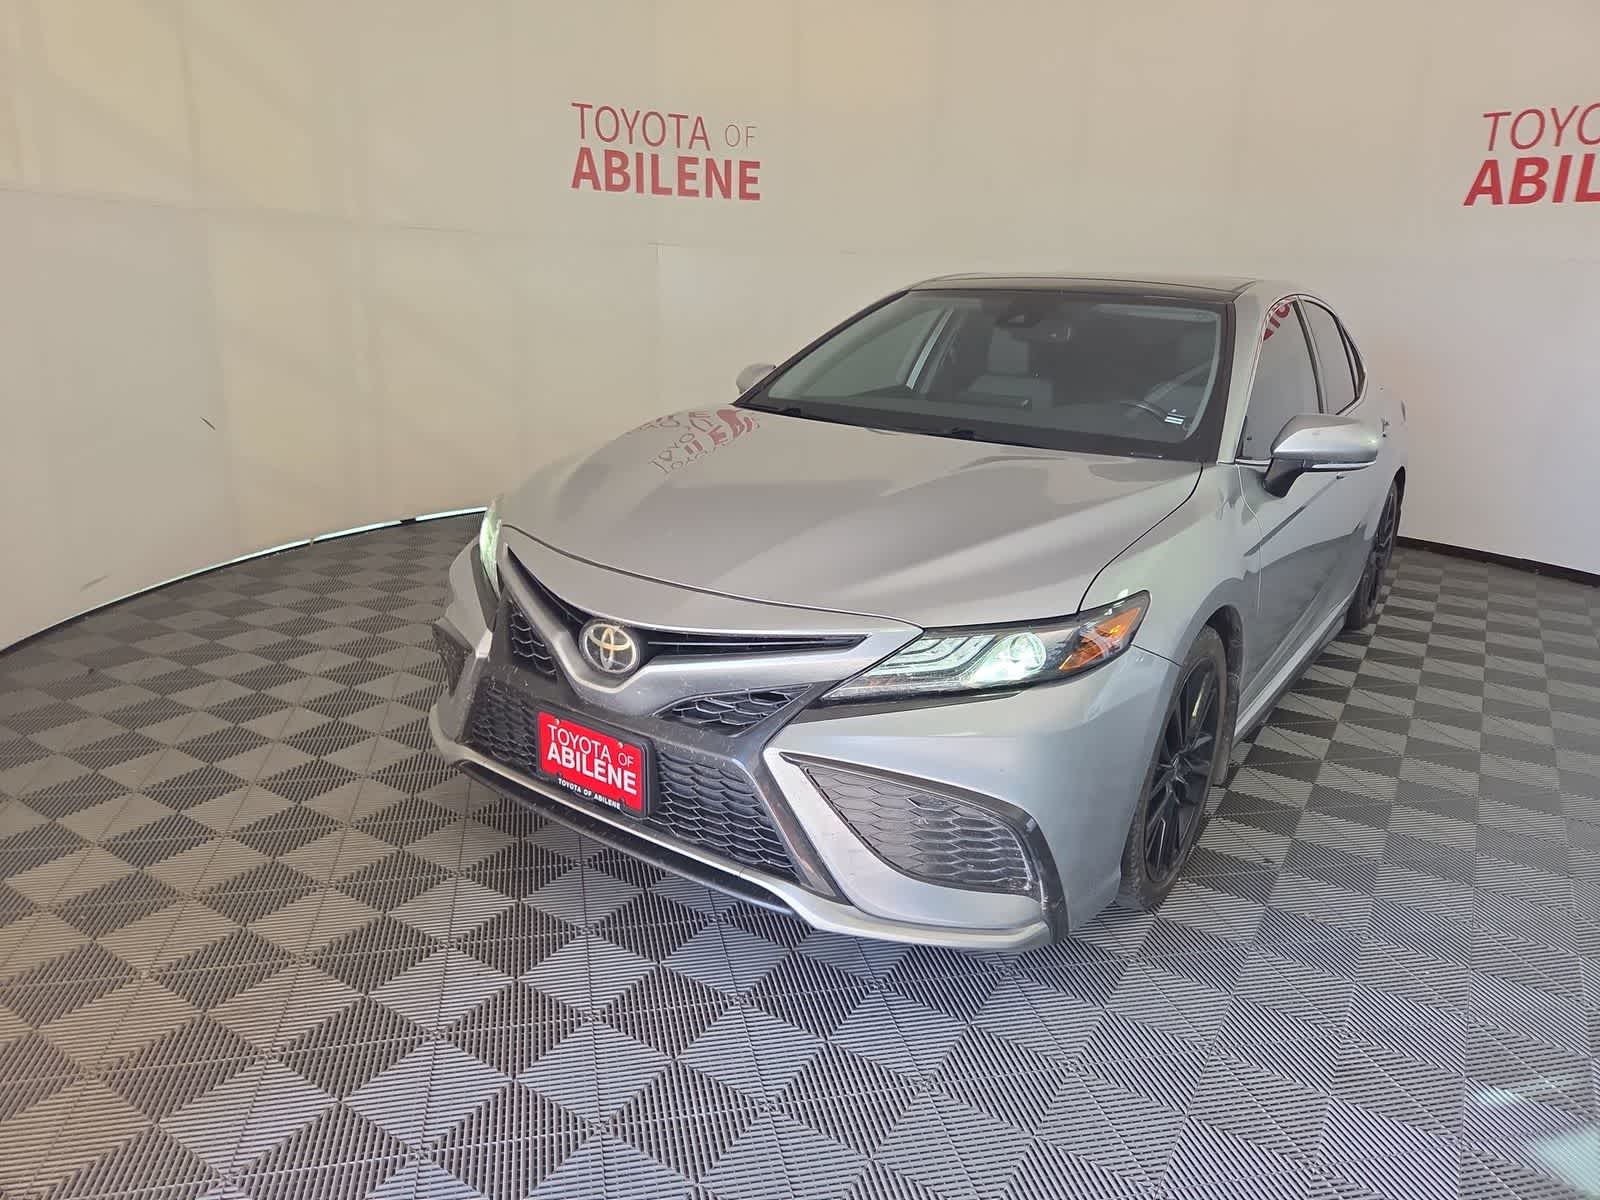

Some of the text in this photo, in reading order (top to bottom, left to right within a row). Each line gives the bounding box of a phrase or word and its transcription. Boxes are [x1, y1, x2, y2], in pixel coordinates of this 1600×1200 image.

[571, 102, 757, 151] TOYOTA OF
[571, 146, 761, 201] ABILENE
[1463, 153, 1600, 206] ABIL
[547, 723, 634, 767] TOYOTA OF
[547, 742, 637, 795] ABILENE
[558, 778, 620, 810] TOYOTA OF ABILENE
